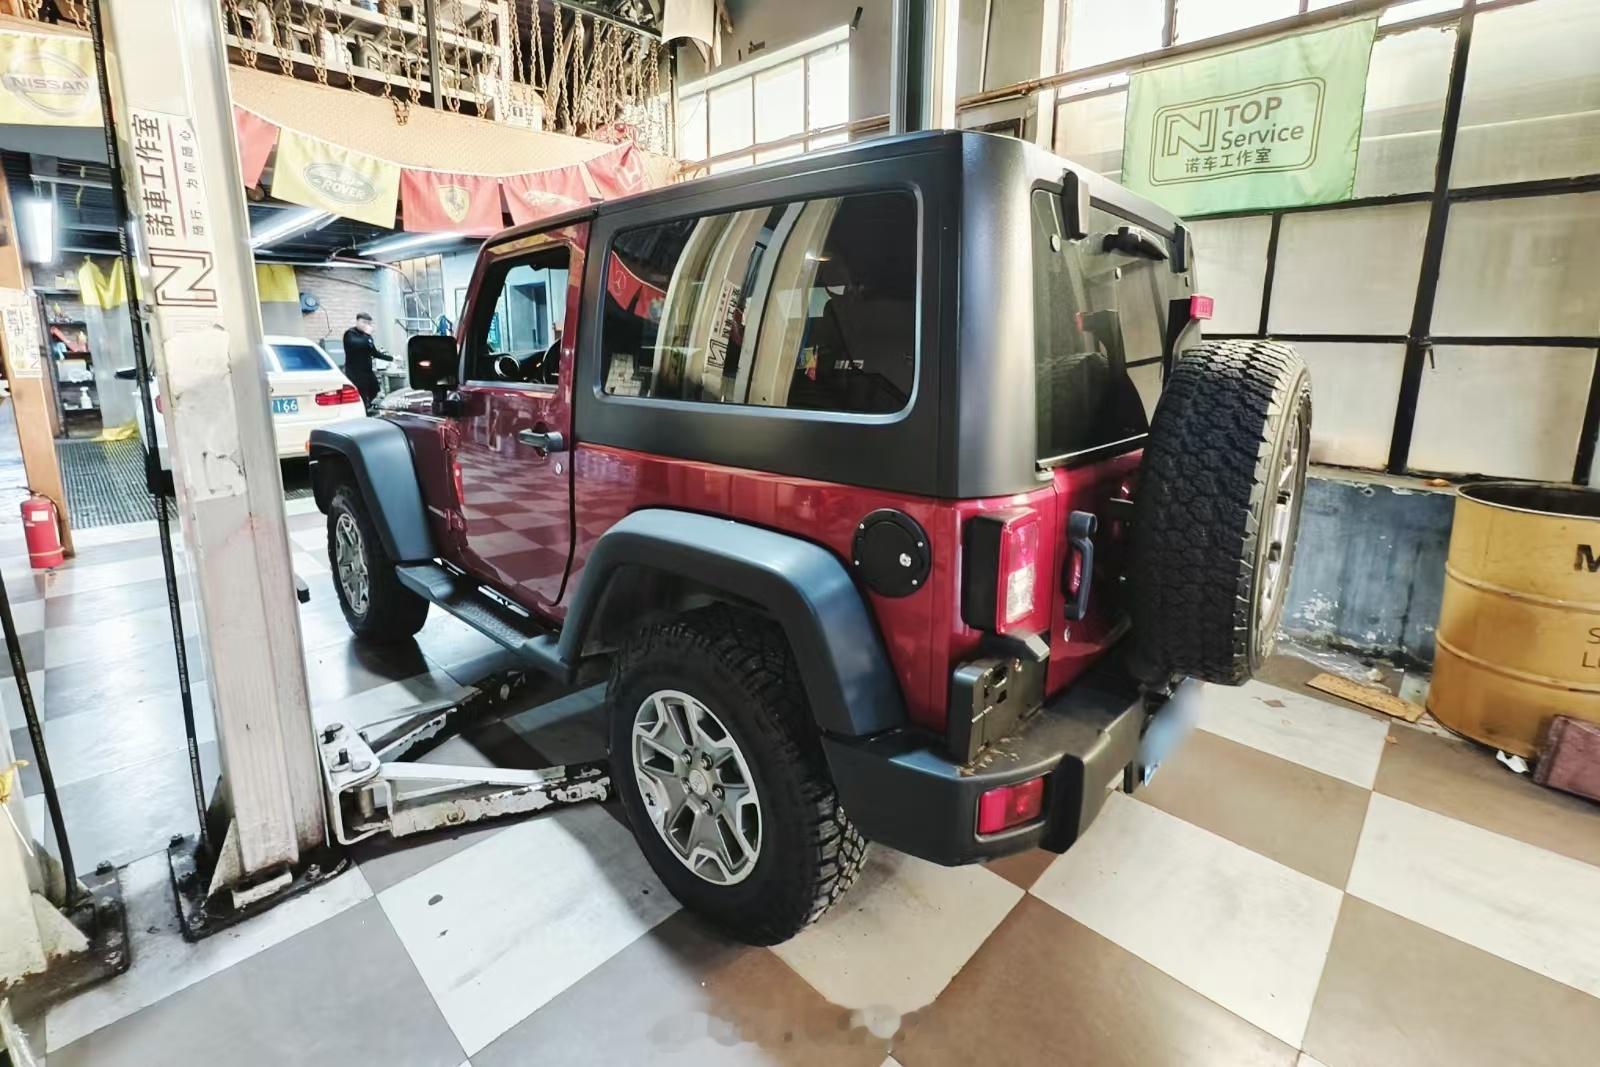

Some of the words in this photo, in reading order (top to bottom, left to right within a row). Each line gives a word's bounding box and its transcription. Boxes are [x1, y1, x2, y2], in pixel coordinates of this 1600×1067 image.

[9, 76, 90, 91] NISSAN
[1224, 96, 1282, 127] TOP
[1221, 123, 1304, 150] Service
[1185, 147, 1272, 173] 诺车工作室
[132, 114, 177, 237] 諾車工作室
[272, 399, 298, 413] 166
